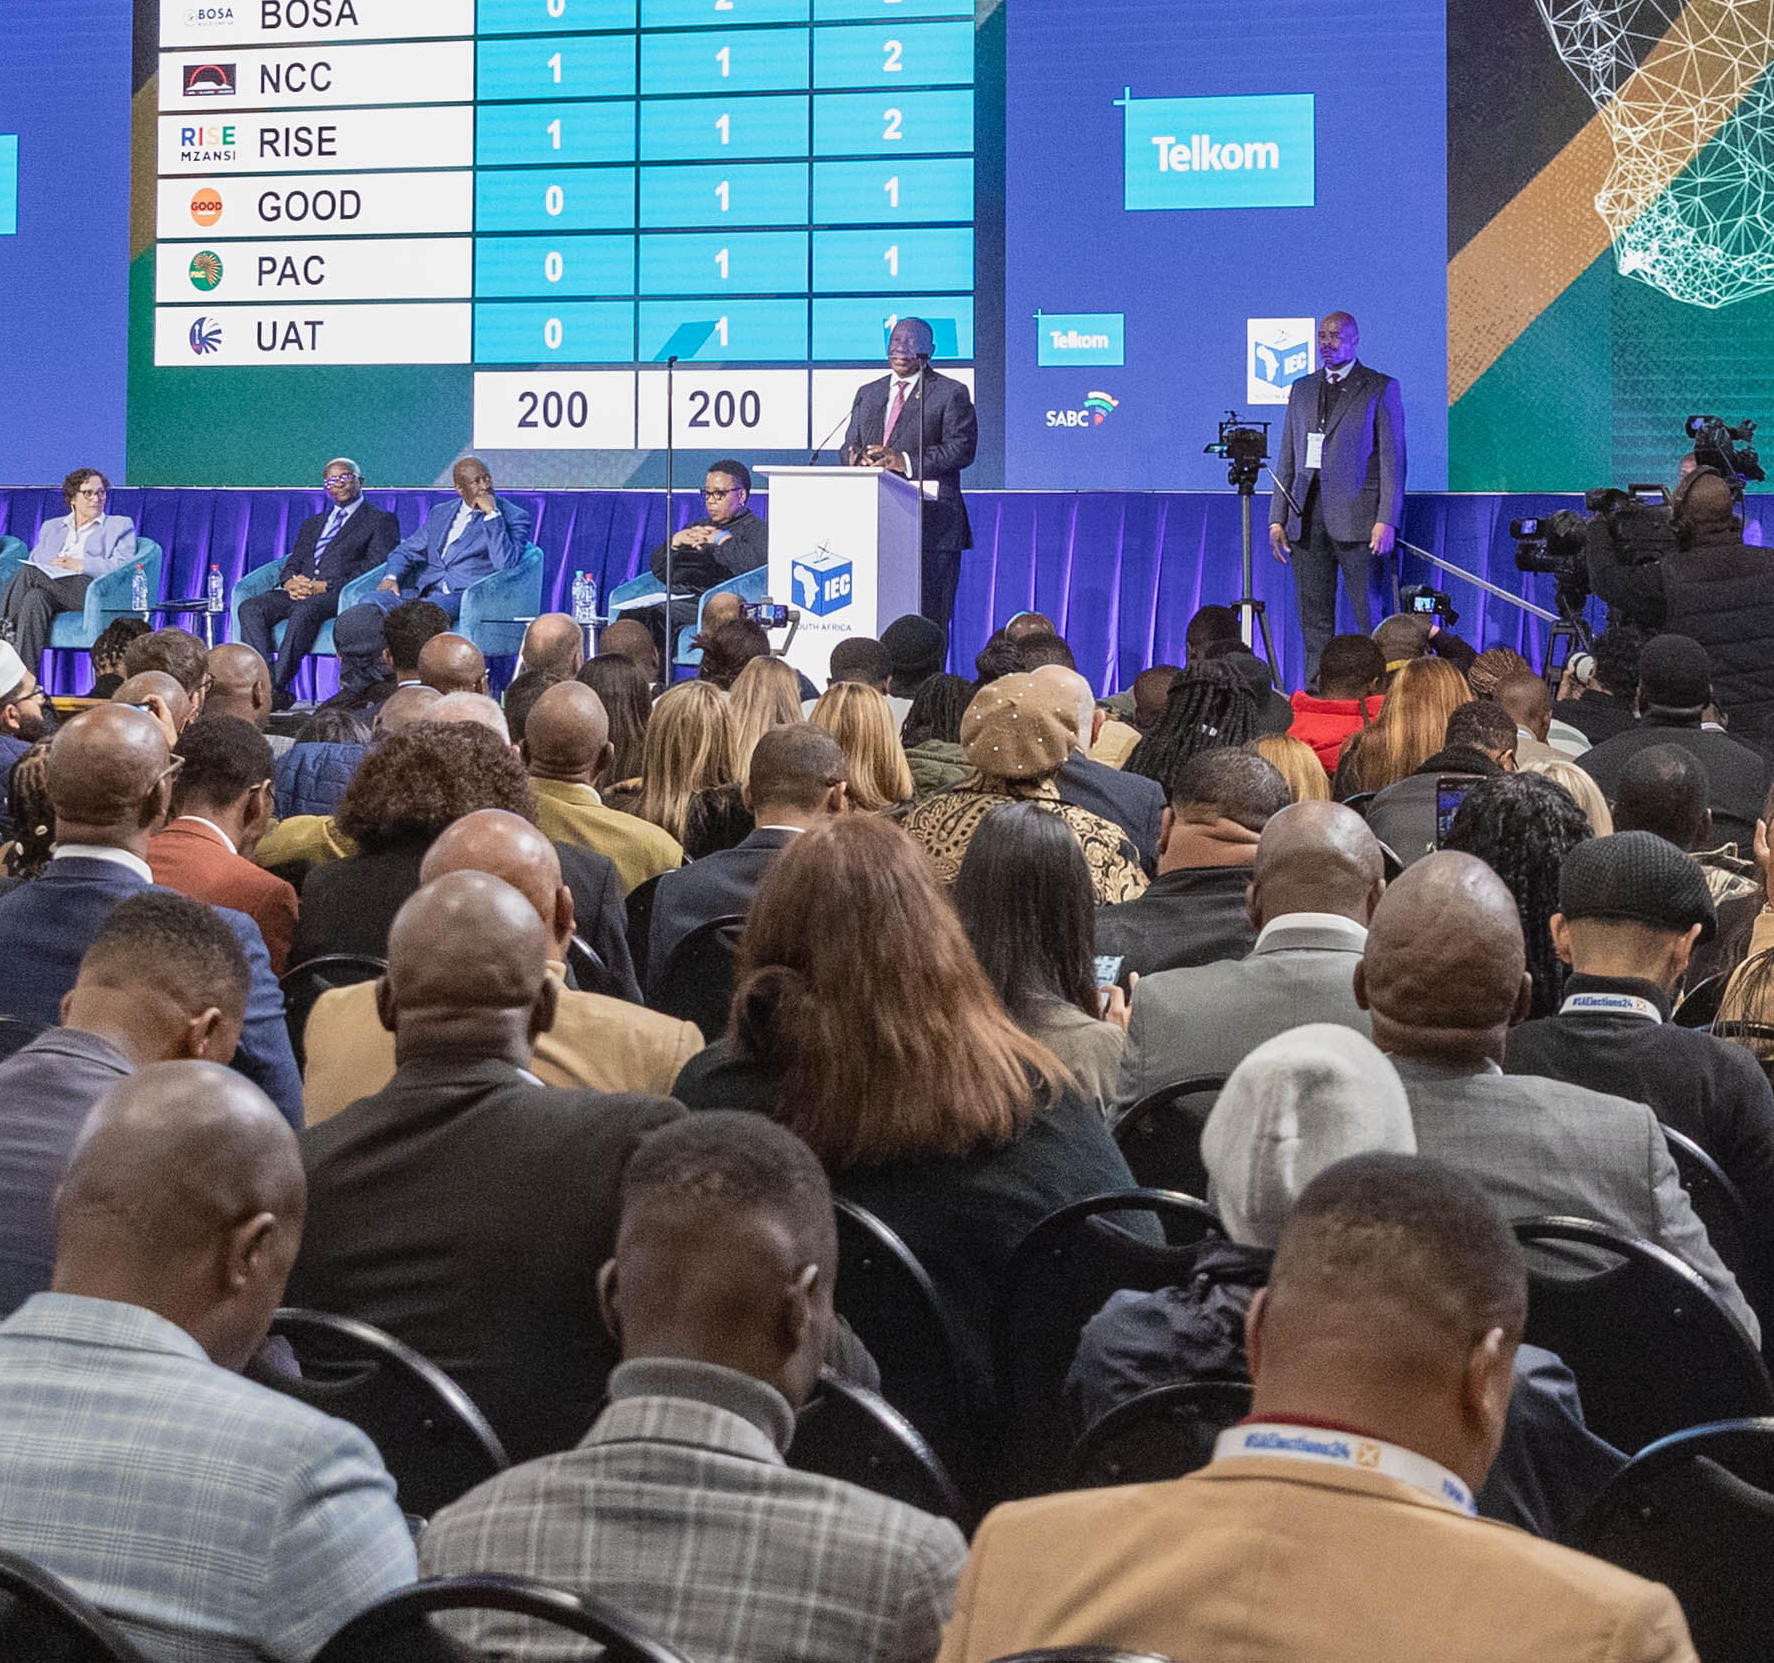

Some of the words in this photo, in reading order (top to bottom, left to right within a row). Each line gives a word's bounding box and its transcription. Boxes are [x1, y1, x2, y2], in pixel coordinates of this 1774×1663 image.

[199, 9, 233, 19] BOSA
[261, 62, 331, 94] NCC
[548, 53, 561, 83] 1
[716, 47, 729, 77] 1
[883, 40, 902, 71] 2
[182, 126, 236, 146] RISE
[260, 126, 336, 157] RISE
[547, 119, 560, 149] 1
[716, 114, 729, 144] 1
[883, 109, 902, 139] 2
[182, 151, 236, 161] MZANSI
[1152, 136, 1279, 173] Telkom
[191, 201, 222, 211] GOOD
[258, 190, 360, 222] GOOD
[546, 185, 563, 216] 0
[715, 181, 729, 211] 1
[884, 177, 898, 207] 1
[258, 255, 324, 286] PAC
[545, 252, 563, 282] 0
[715, 249, 728, 279] 1
[884, 246, 898, 276] 1
[257, 321, 323, 351] UAT
[544, 318, 562, 349] 0
[715, 316, 728, 347] 1
[1050, 331, 1108, 349] Telkom
[1285, 352, 1307, 375] IEC
[518, 391, 587, 428] 200
[689, 390, 760, 427] 200
[1046, 410, 1089, 427] SABC
[825, 574, 850, 601] IEC
[1573, 996, 1632, 1008] #SAElections24
